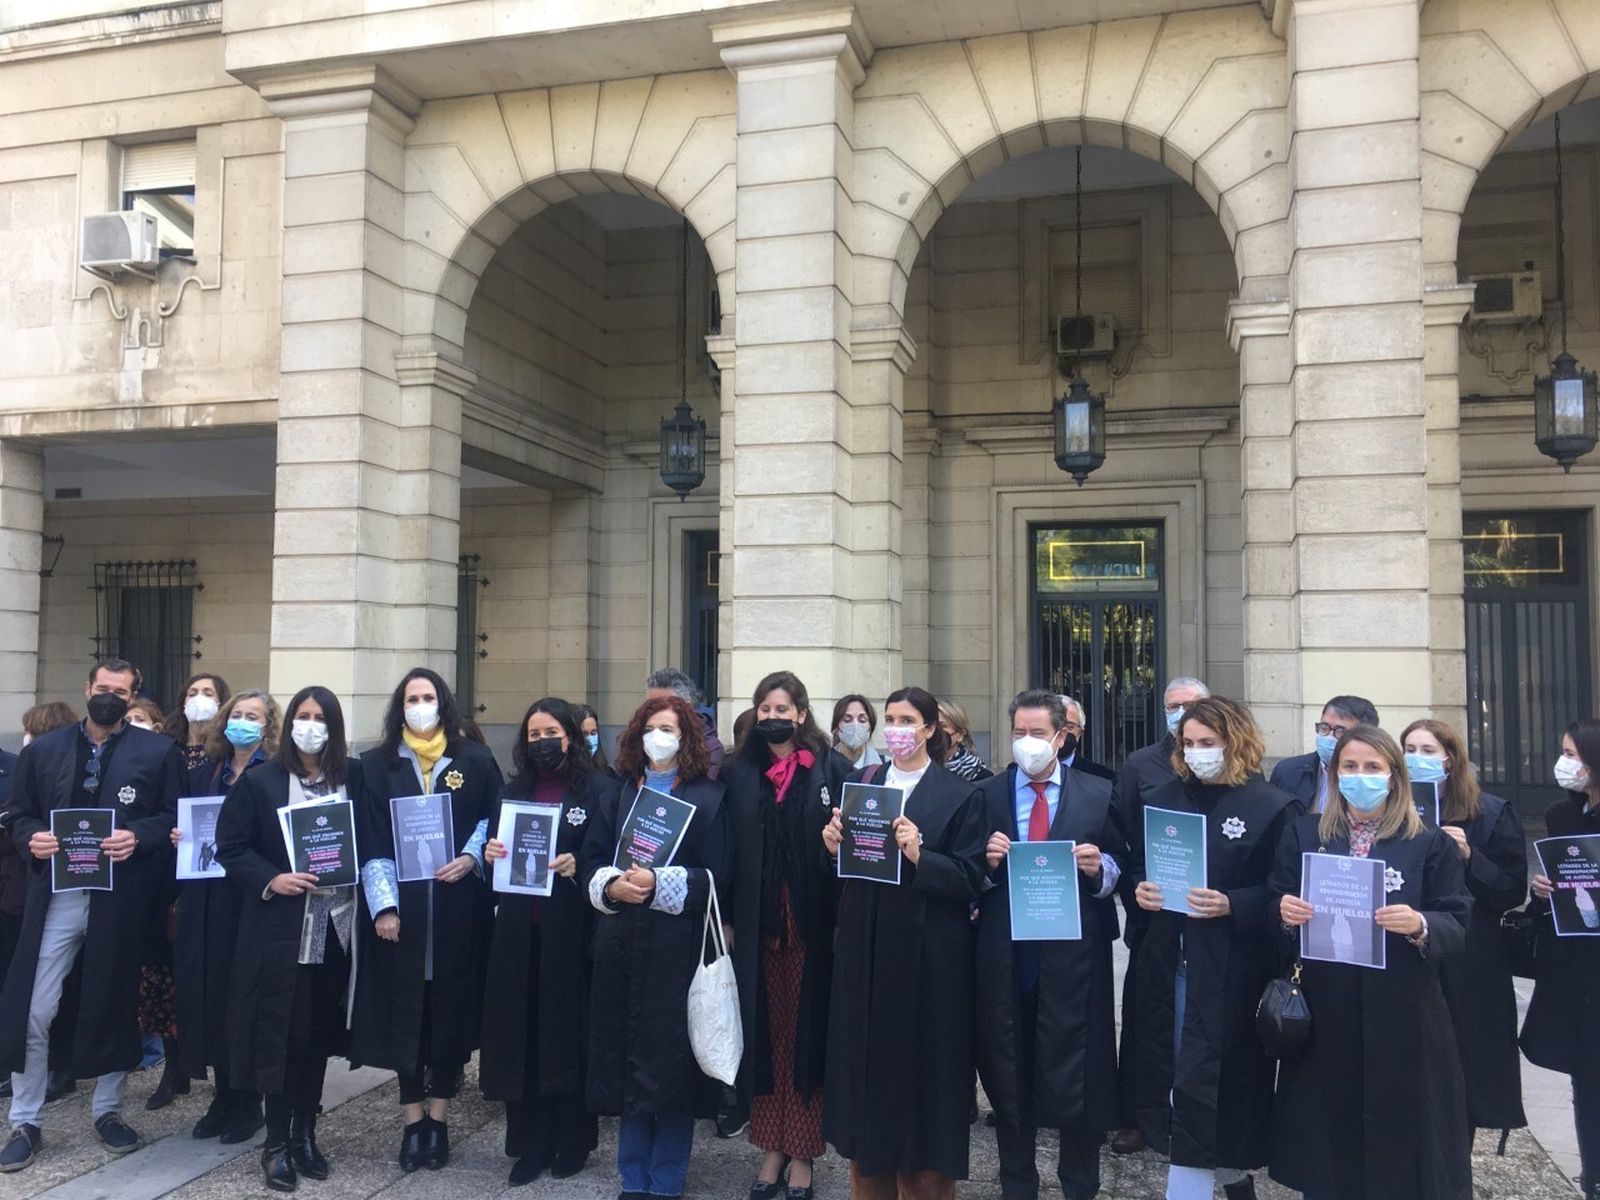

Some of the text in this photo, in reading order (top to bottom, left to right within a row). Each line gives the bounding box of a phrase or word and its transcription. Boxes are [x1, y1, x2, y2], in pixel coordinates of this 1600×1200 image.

[416, 832, 445, 840] HUELGA
[1319, 880, 1350, 889] LETRADOS
[1319, 888, 1368, 898] ADMINISTRACIÓN
[1335, 898, 1360, 906] JUSTICIA
[1314, 904, 1372, 919] EN HUELGA
